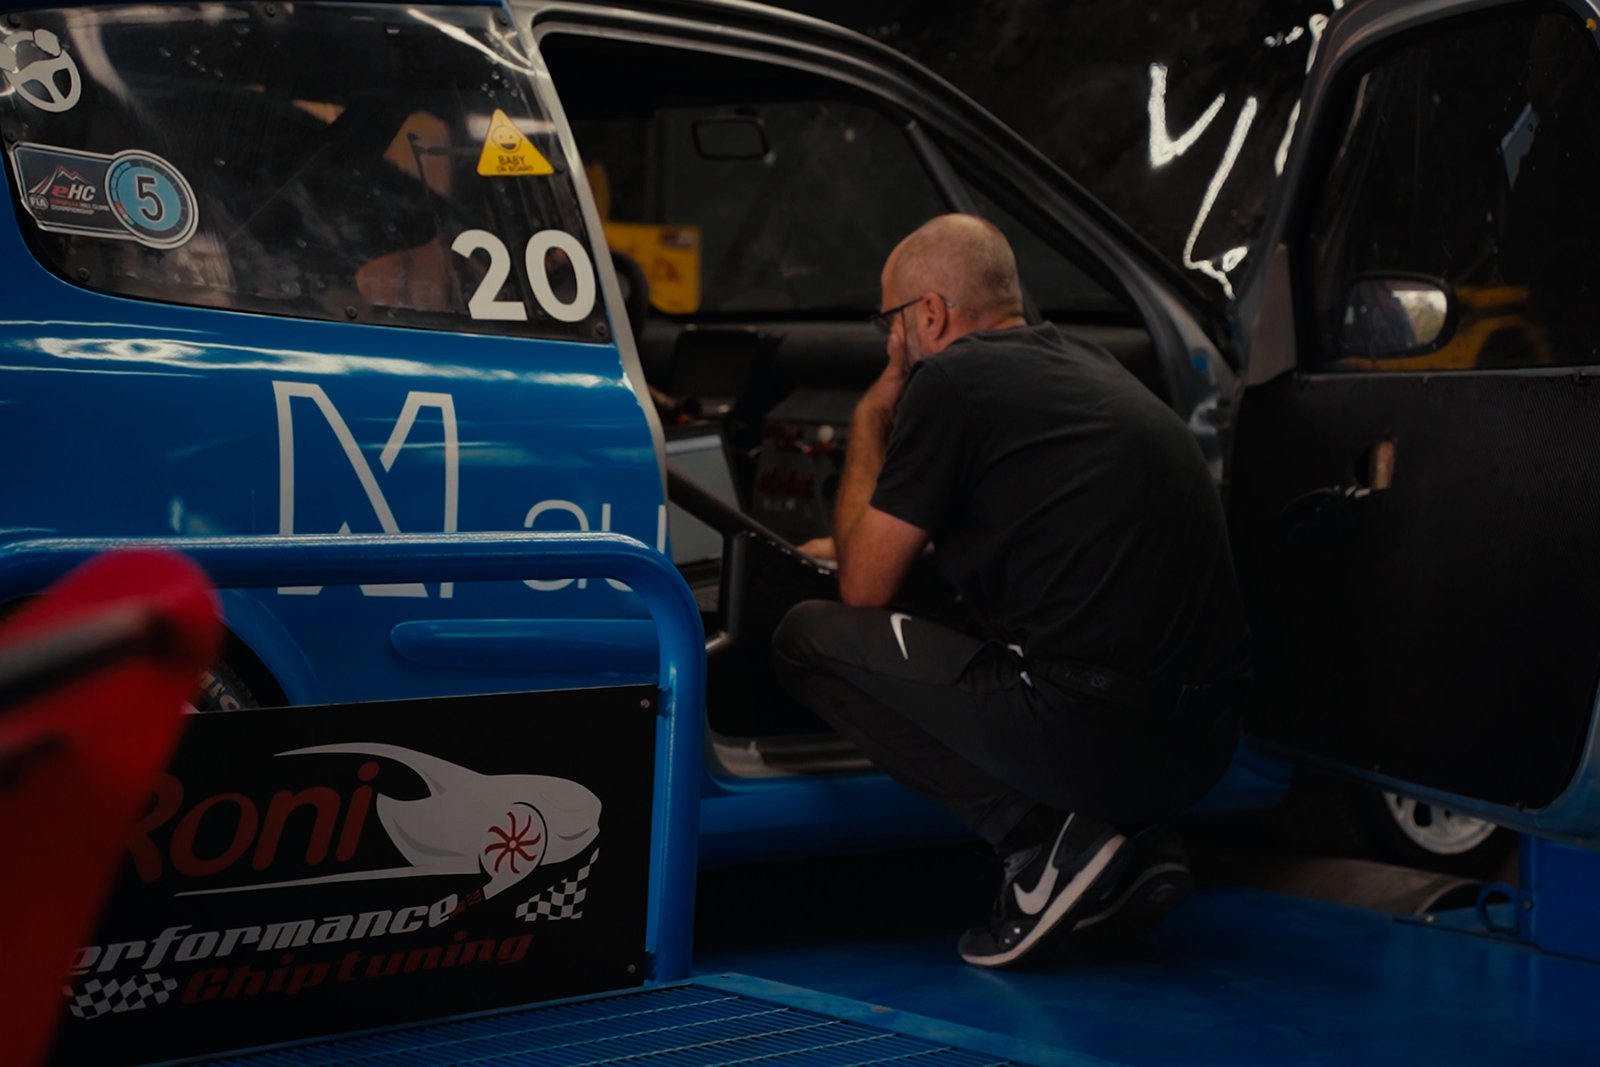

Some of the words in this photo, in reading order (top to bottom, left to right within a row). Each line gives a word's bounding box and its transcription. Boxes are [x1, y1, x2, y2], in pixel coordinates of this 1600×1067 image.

[51, 183, 96, 202] eHC
[497, 155, 526, 165] BABY
[136, 175, 164, 222] 5
[450, 229, 596, 322] 20
[128, 761, 381, 884] Roni
[68, 893, 459, 976] erformance
[180, 929, 536, 1005] Chiptuning
